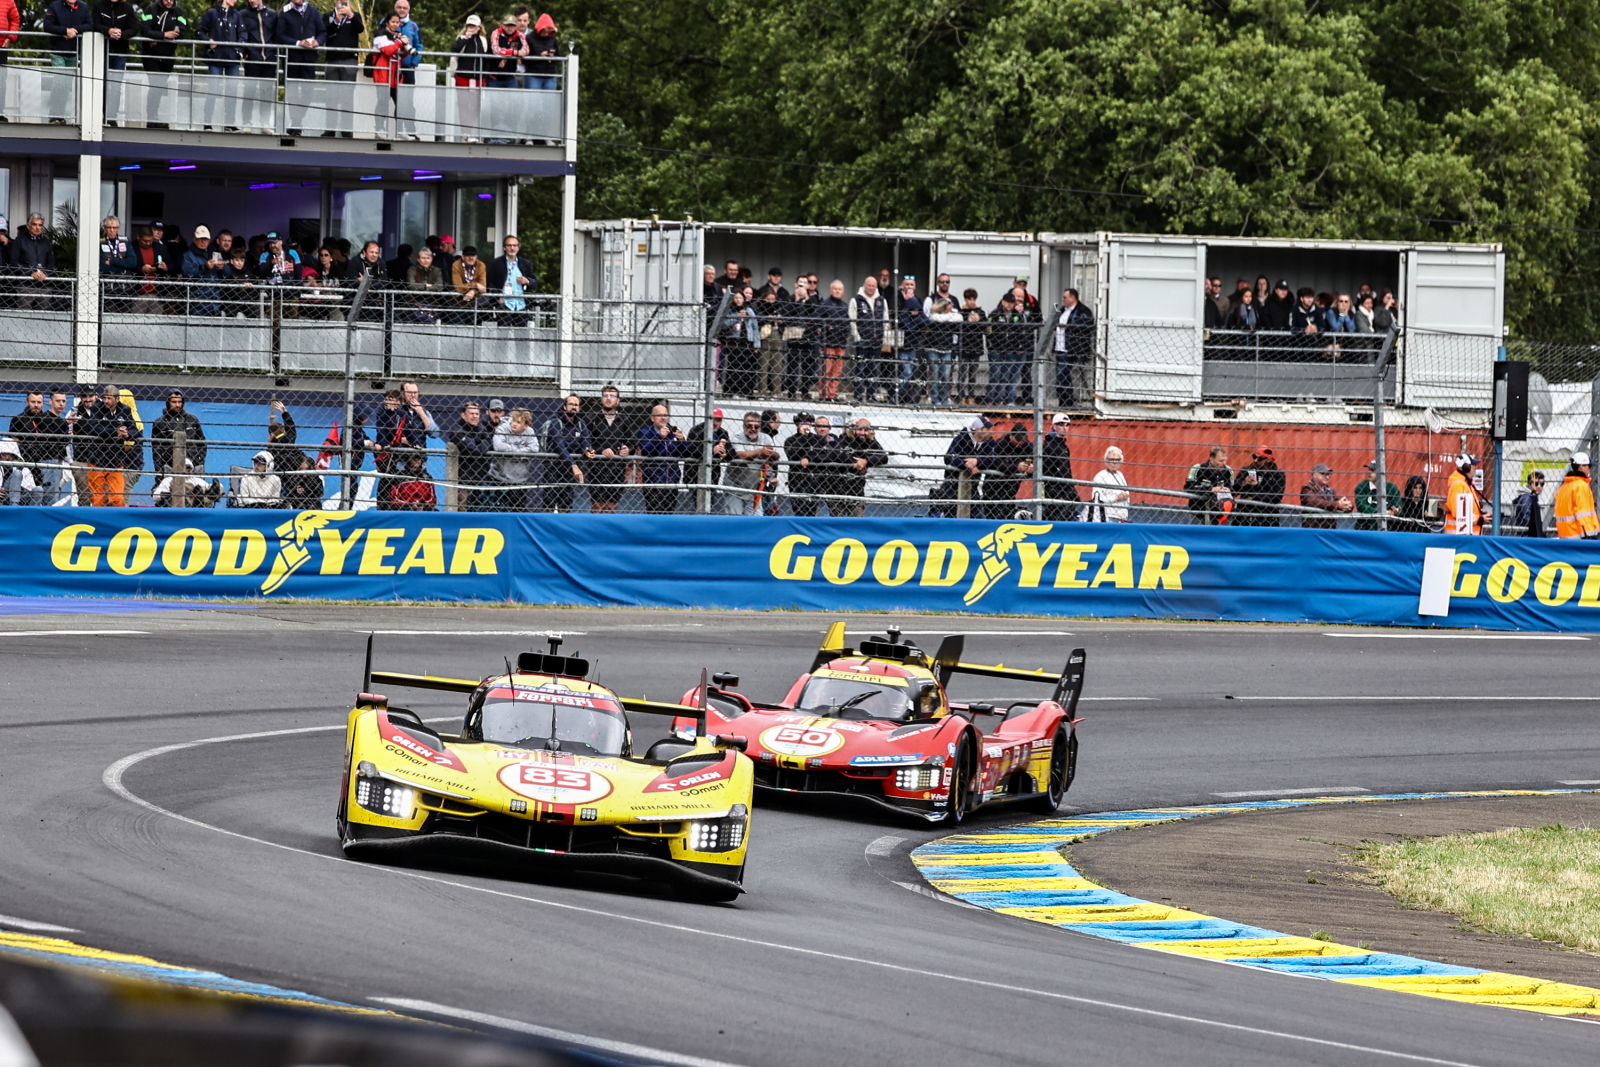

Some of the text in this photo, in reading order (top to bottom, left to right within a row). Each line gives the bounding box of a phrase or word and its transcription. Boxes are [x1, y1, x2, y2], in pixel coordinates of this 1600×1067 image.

[515, 690, 596, 709] Ferrari
[776, 727, 828, 745] 50
[391, 735, 434, 758] ORLEN
[501, 751, 528, 760] HY
[395, 767, 480, 793] RICHARD MILLE
[523, 767, 588, 788] 83
[679, 771, 722, 787] ORLEN
[630, 803, 679, 812] RICHARD
